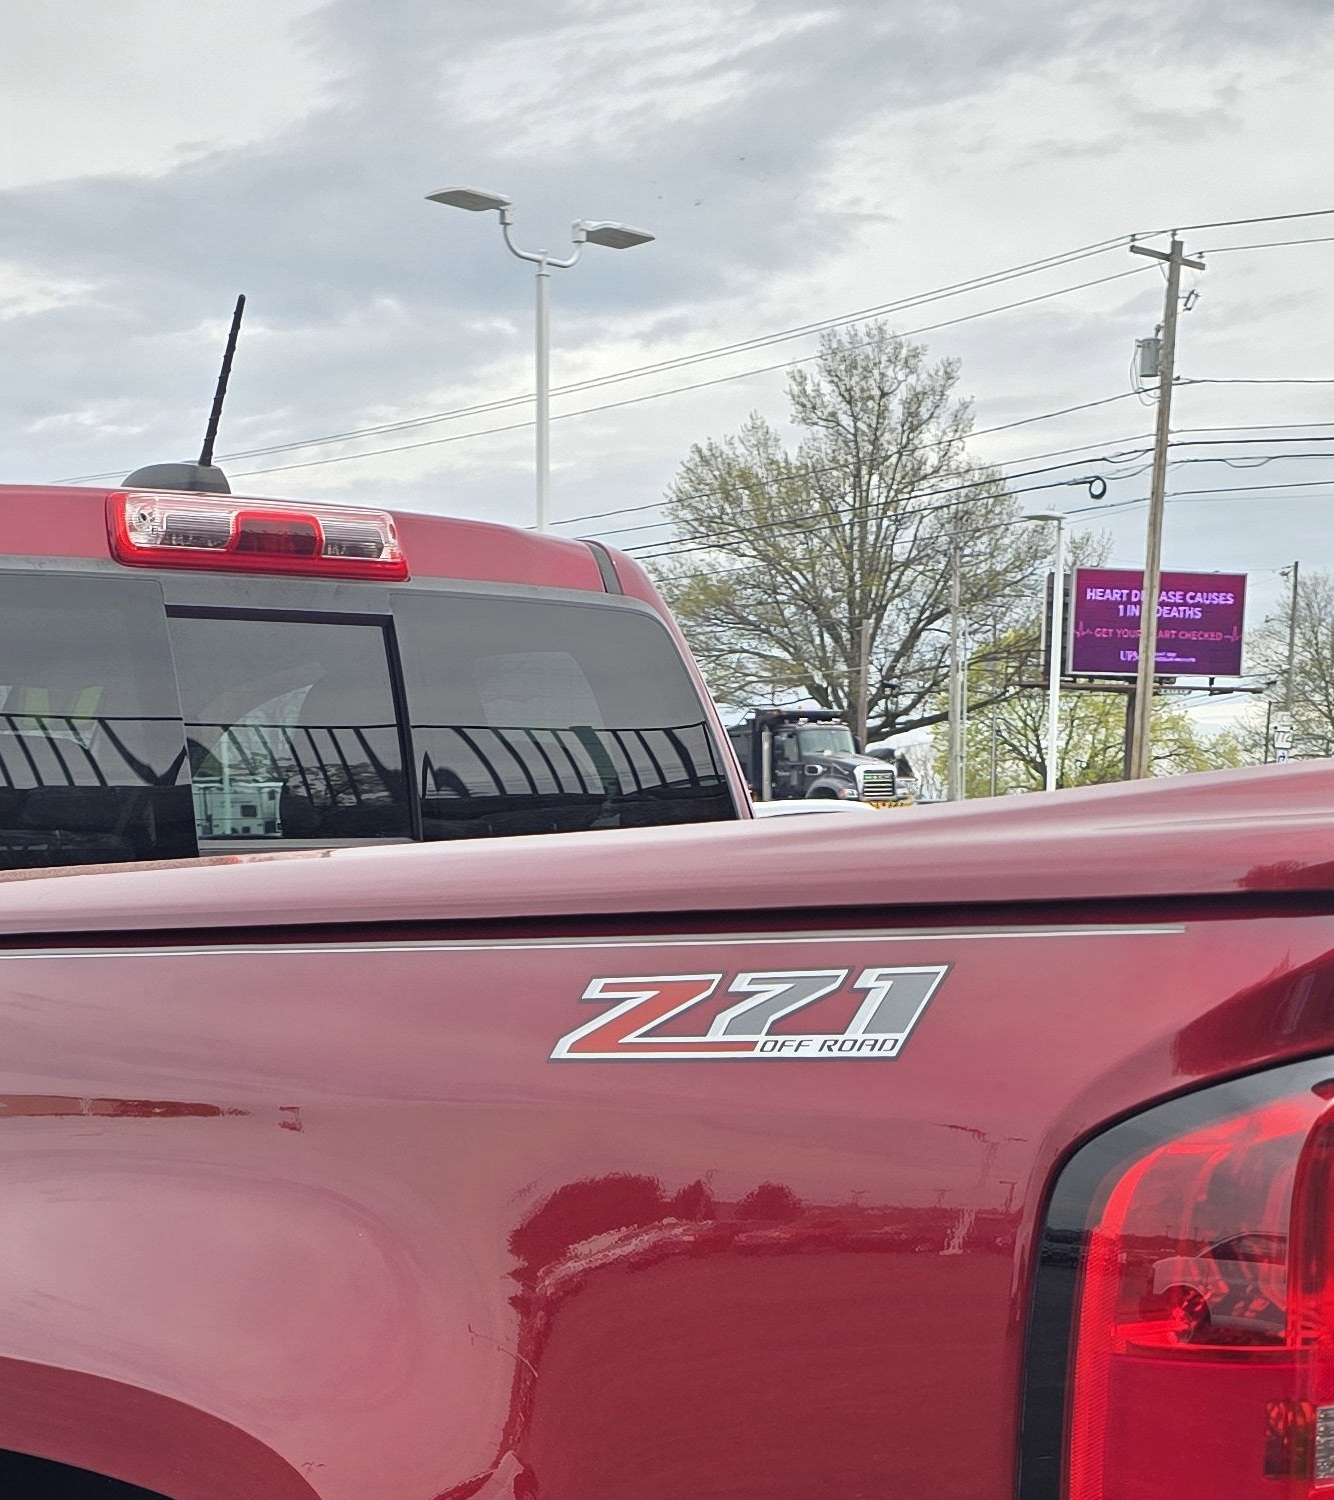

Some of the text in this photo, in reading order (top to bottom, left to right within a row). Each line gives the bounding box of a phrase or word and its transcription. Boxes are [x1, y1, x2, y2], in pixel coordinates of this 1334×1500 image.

[1086, 588, 1235, 605] HEART DIASE CAUSES
[1126, 605, 1140, 617] IN
[1094, 627, 1114, 639] GET
[1178, 631, 1223, 641] CHECKED
[549, 965, 950, 1059] Z71
[759, 1037, 899, 1054] OFF ROAD
